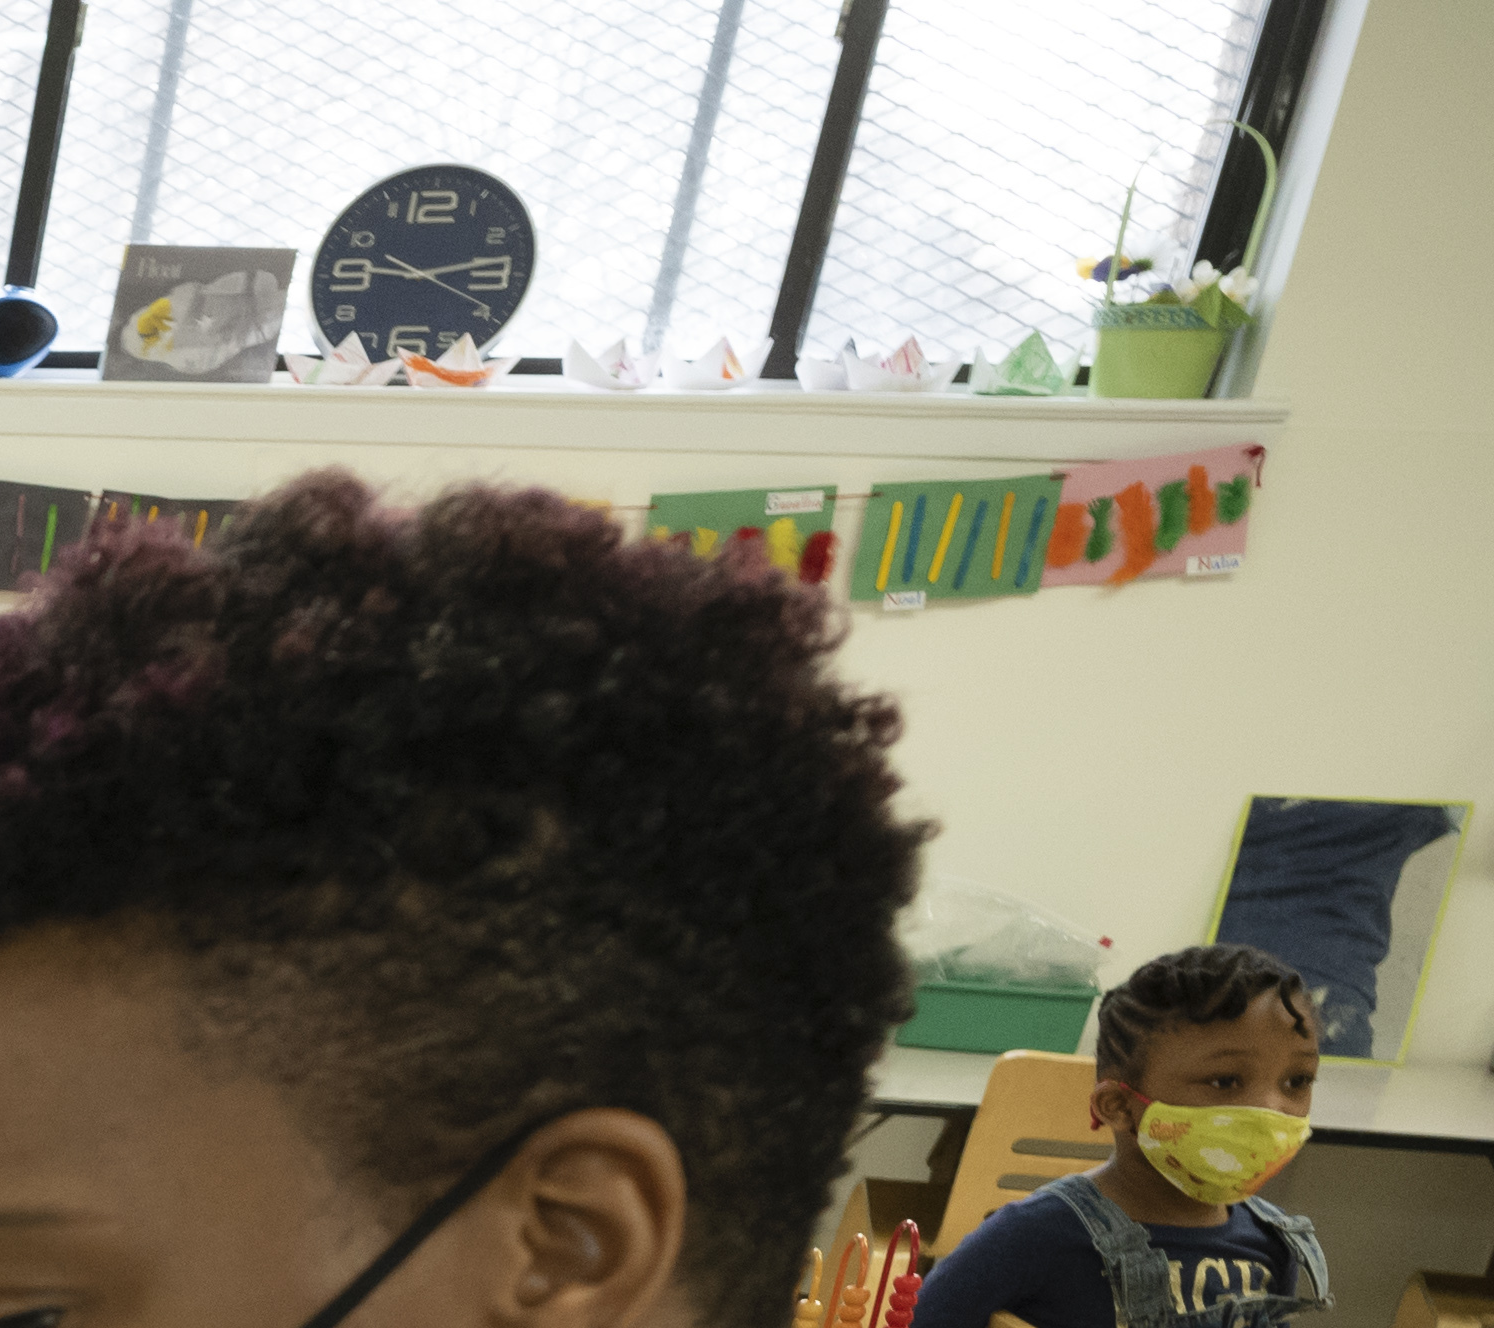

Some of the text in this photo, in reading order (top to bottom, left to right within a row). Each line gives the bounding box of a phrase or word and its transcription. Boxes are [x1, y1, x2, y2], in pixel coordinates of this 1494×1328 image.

[405, 189, 460, 225] 12
[485, 226, 506, 245] 2
[328, 257, 372, 292] 9
[468, 255, 511, 291] 3
[334, 304, 357, 322] 8
[388, 325, 430, 358] 6
